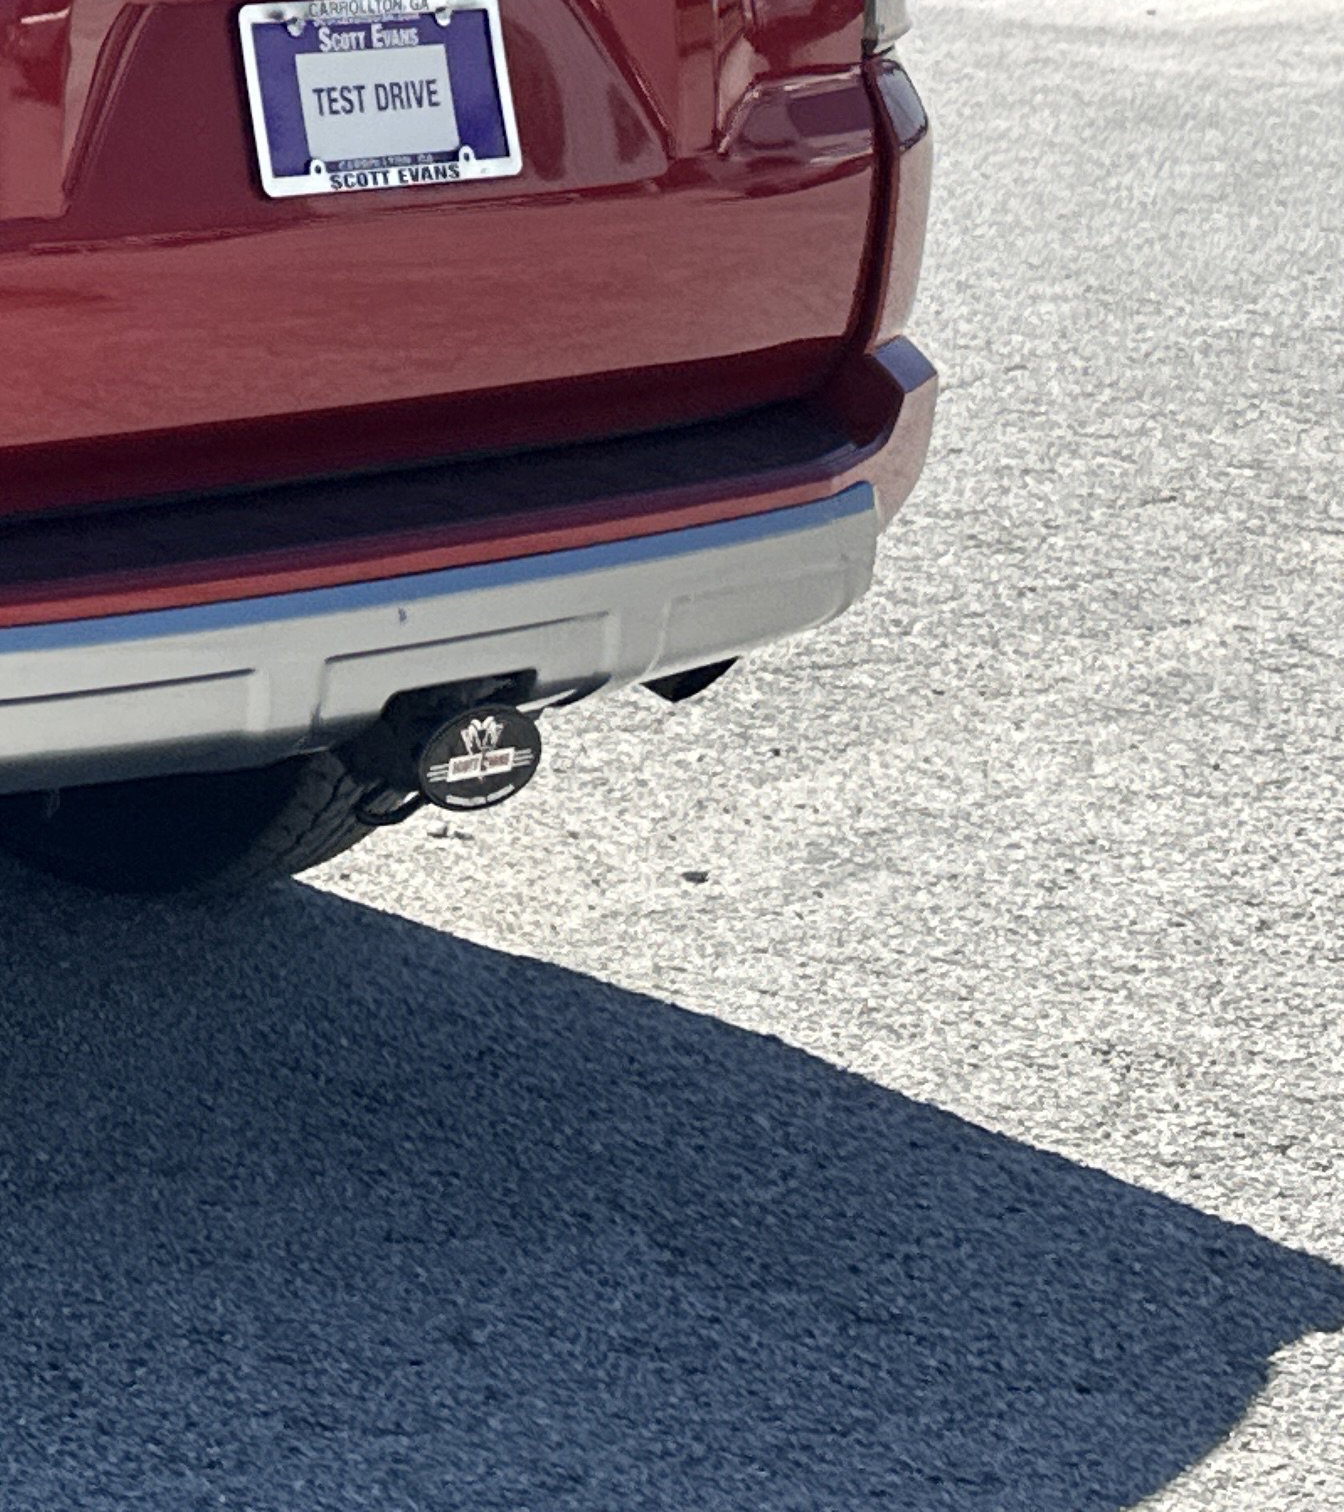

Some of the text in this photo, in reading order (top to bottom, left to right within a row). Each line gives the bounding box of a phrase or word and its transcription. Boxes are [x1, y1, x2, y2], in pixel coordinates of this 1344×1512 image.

[313, 79, 441, 116] TEST DRIVE
[330, 163, 460, 190] SCOTT EVANS
